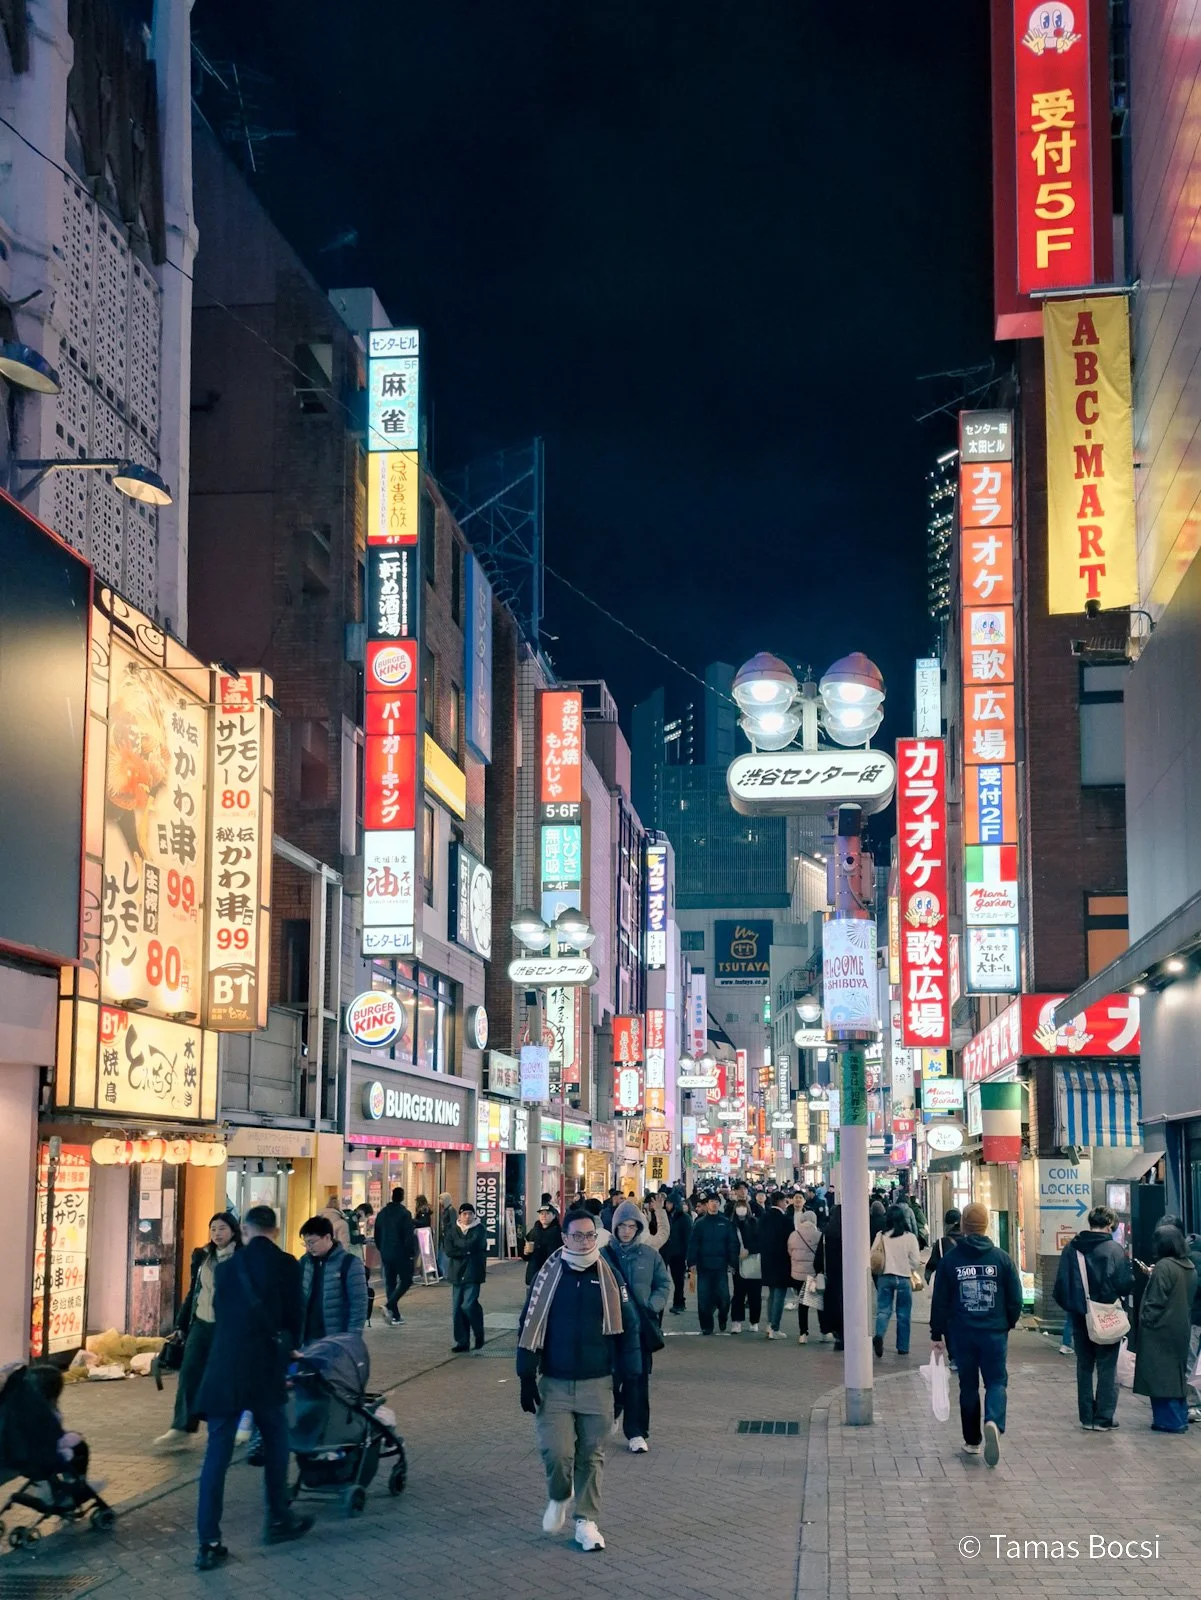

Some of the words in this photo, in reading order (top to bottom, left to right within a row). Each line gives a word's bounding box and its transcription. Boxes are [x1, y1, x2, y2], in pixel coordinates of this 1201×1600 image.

[1031, 89, 1075, 269] 受付5F
[372, 336, 417, 351] センタービル
[404, 360, 417, 369] 5F
[382, 372, 406, 433] 麻雀
[965, 423, 1008, 435] センター街
[968, 439, 1005, 454] 太田ビル
[1071, 311, 1106, 599] ABC-MART
[386, 536, 400, 544] 4F
[378, 655, 405, 669] BURGER
[379, 661, 407, 677] KING
[171, 712, 198, 747] 秘伝
[562, 699, 579, 765] お好み焼
[217, 720, 237, 785] サワー
[237, 714, 258, 783] レモン
[380, 700, 402, 824] バーガーキング
[545, 732, 562, 797] もんじゃ
[737, 765, 886, 787] 渋谷センター街
[170, 746, 196, 866] かわ串
[221, 789, 250, 809] 80
[979, 768, 1003, 842] 受付2F
[904, 742, 941, 887] カラオケ
[216, 827, 254, 842] 秘伝
[545, 829, 560, 873] 無呼吸
[563, 828, 578, 874] いびき
[215, 845, 252, 923] かわ串
[555, 882, 568, 890] 4F
[120, 861, 139, 966] レモン
[217, 928, 249, 950] 99
[365, 934, 412, 947] センタービル
[719, 962, 769, 972] TSUTAYA
[977, 962, 1012, 973] 大ホール
[213, 974, 250, 1004] B1
[828, 978, 868, 990] SHIBUYA
[905, 930, 945, 1038] 歌広場
[102, 1011, 119, 1035] B1
[353, 1002, 394, 1021] BURGER
[355, 1011, 396, 1034] KING
[103, 1048, 119, 1104] 焼鳥
[184, 1037, 197, 1107] 水炊き
[385, 1089, 433, 1122] BURGER
[434, 1098, 460, 1127] KING
[1041, 1183, 1090, 1195] LOCKER
[1048, 1168, 1078, 1180] COIN
[477, 1177, 486, 1217] GANSO
[486, 1177, 496, 1233] ABURADO
[55, 1209, 85, 1225] サワー
